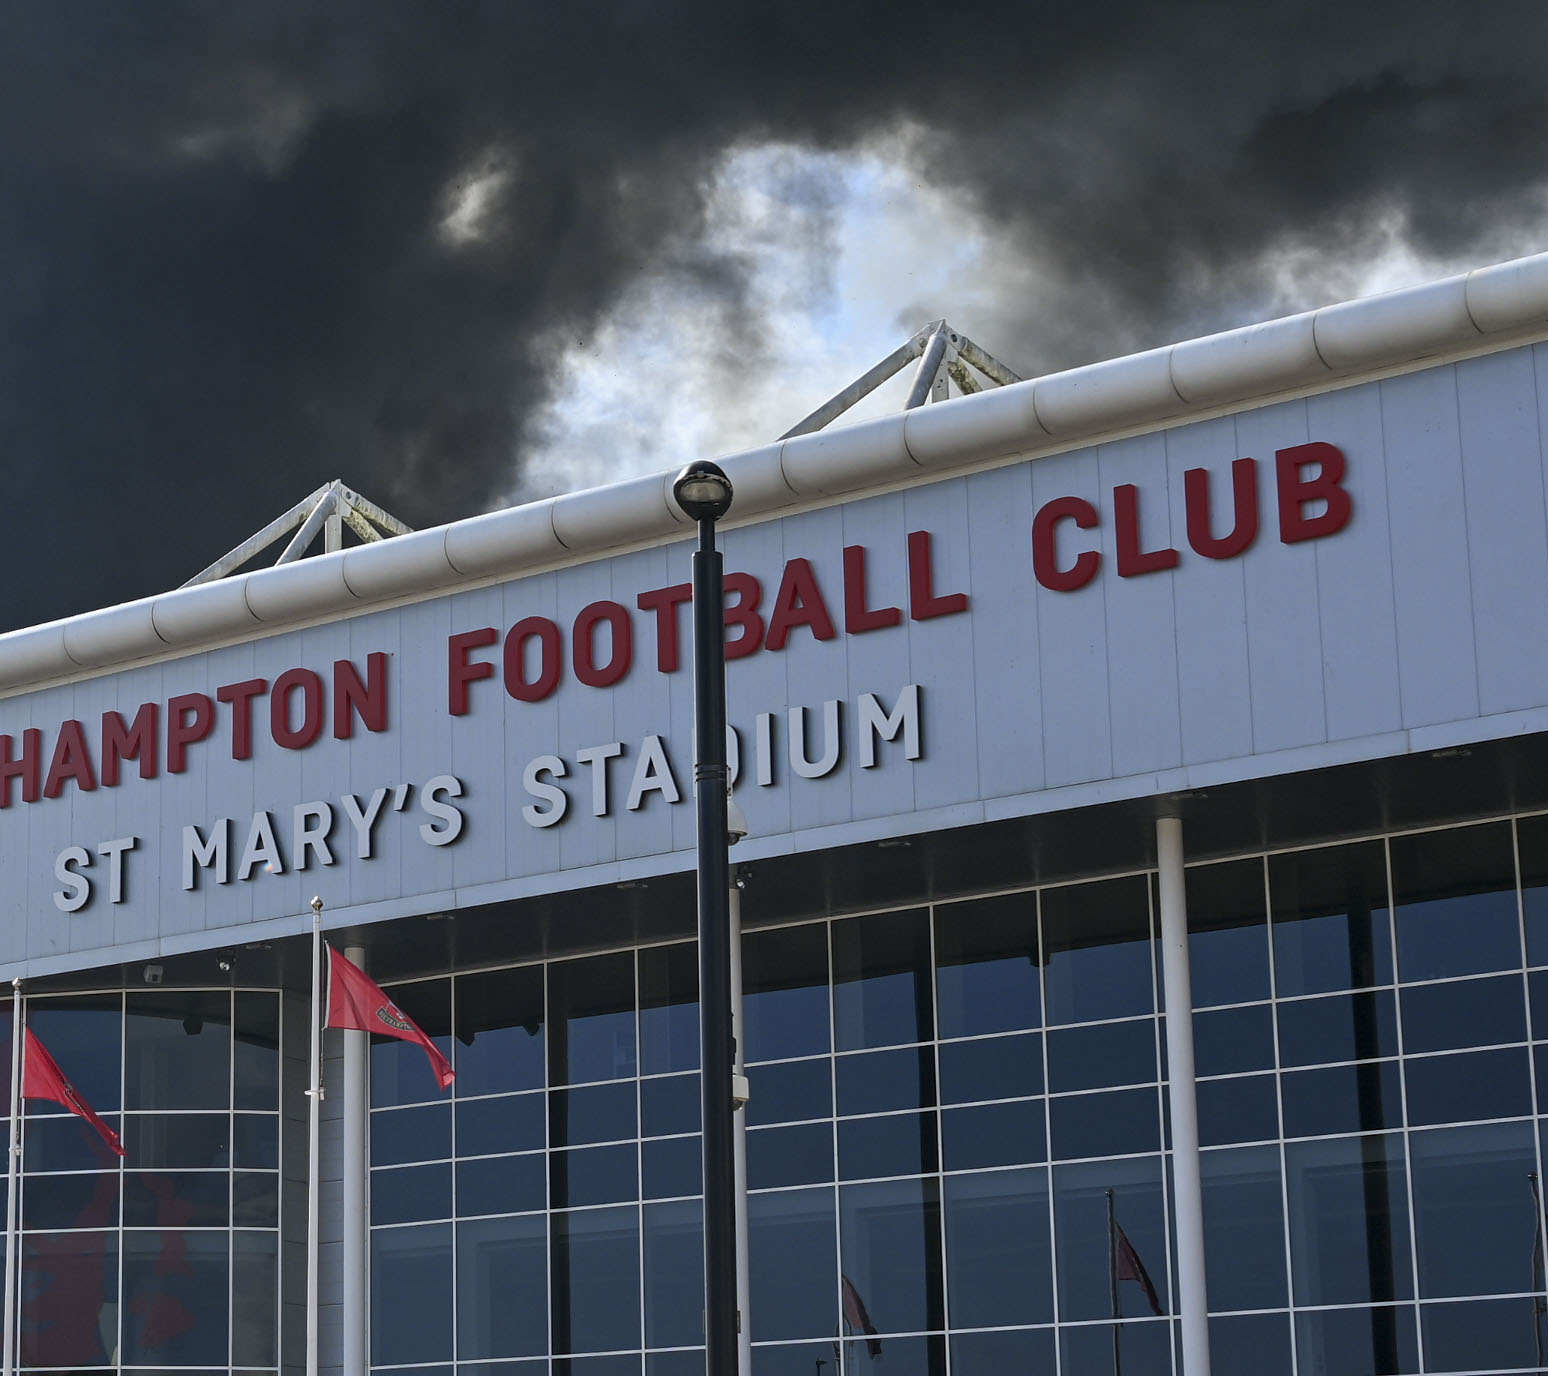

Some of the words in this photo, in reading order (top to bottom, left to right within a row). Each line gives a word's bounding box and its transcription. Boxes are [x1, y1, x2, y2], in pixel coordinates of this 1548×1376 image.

[448, 530, 968, 716] FOOTBALL
[1031, 441, 1353, 592] CLUB
[52, 836, 140, 913] ST
[181, 774, 463, 892] MARY'S
